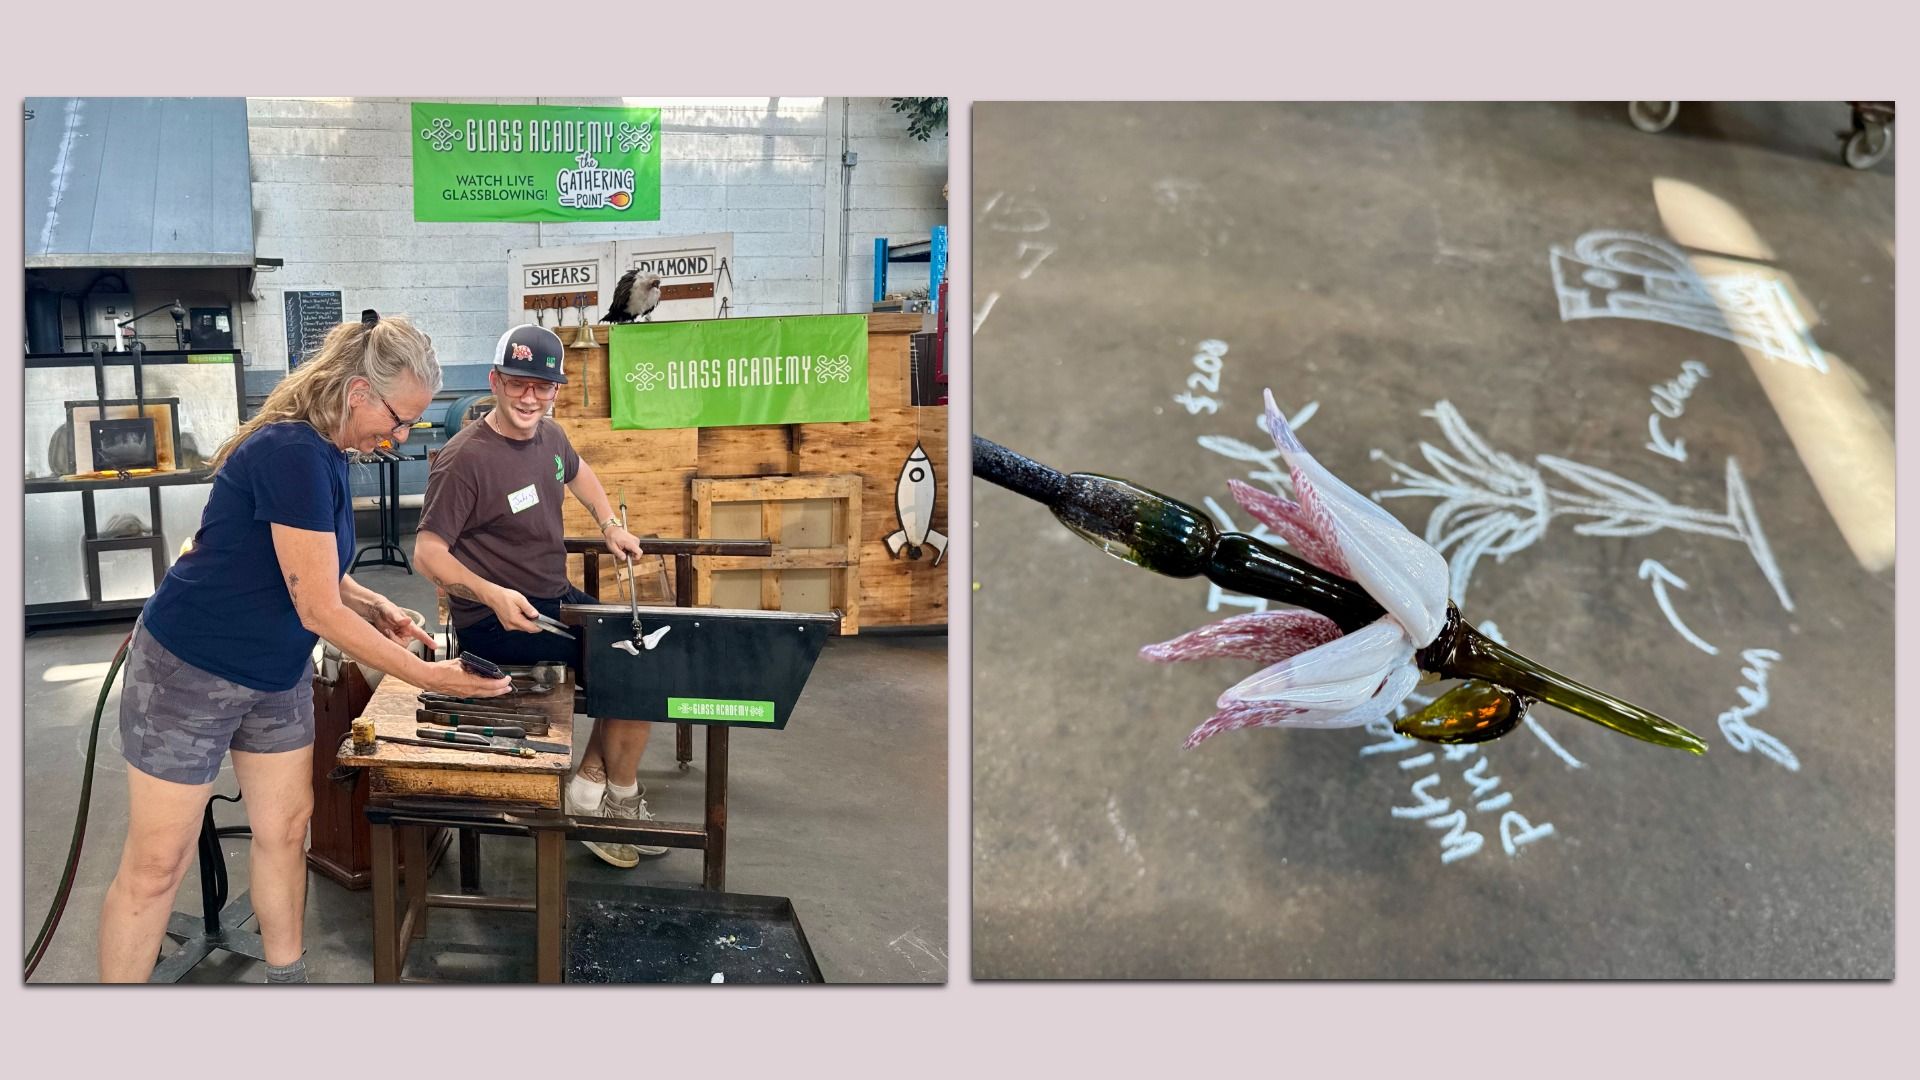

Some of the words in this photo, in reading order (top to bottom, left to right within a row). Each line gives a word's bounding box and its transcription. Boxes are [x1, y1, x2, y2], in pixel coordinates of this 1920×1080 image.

[466, 119, 523, 152] GLASS
[529, 121, 614, 153] ACADEMY
[577, 152, 597, 169] the
[456, 175, 503, 187] WATCH
[507, 175, 534, 187] LIVE
[558, 170, 633, 193] GATHERING
[442, 189, 548, 201] GLASSBLOWING!
[576, 193, 603, 208] POINT
[640, 257, 708, 276] DIAMOND
[531, 267, 591, 286] SHEARS
[667, 359, 721, 390] GLASS
[727, 355, 812, 387] ACADEMY
[1174, 339, 1228, 415] $200
[693, 703, 715, 716] GLASS
[716, 704, 749, 717] ACADEMY
